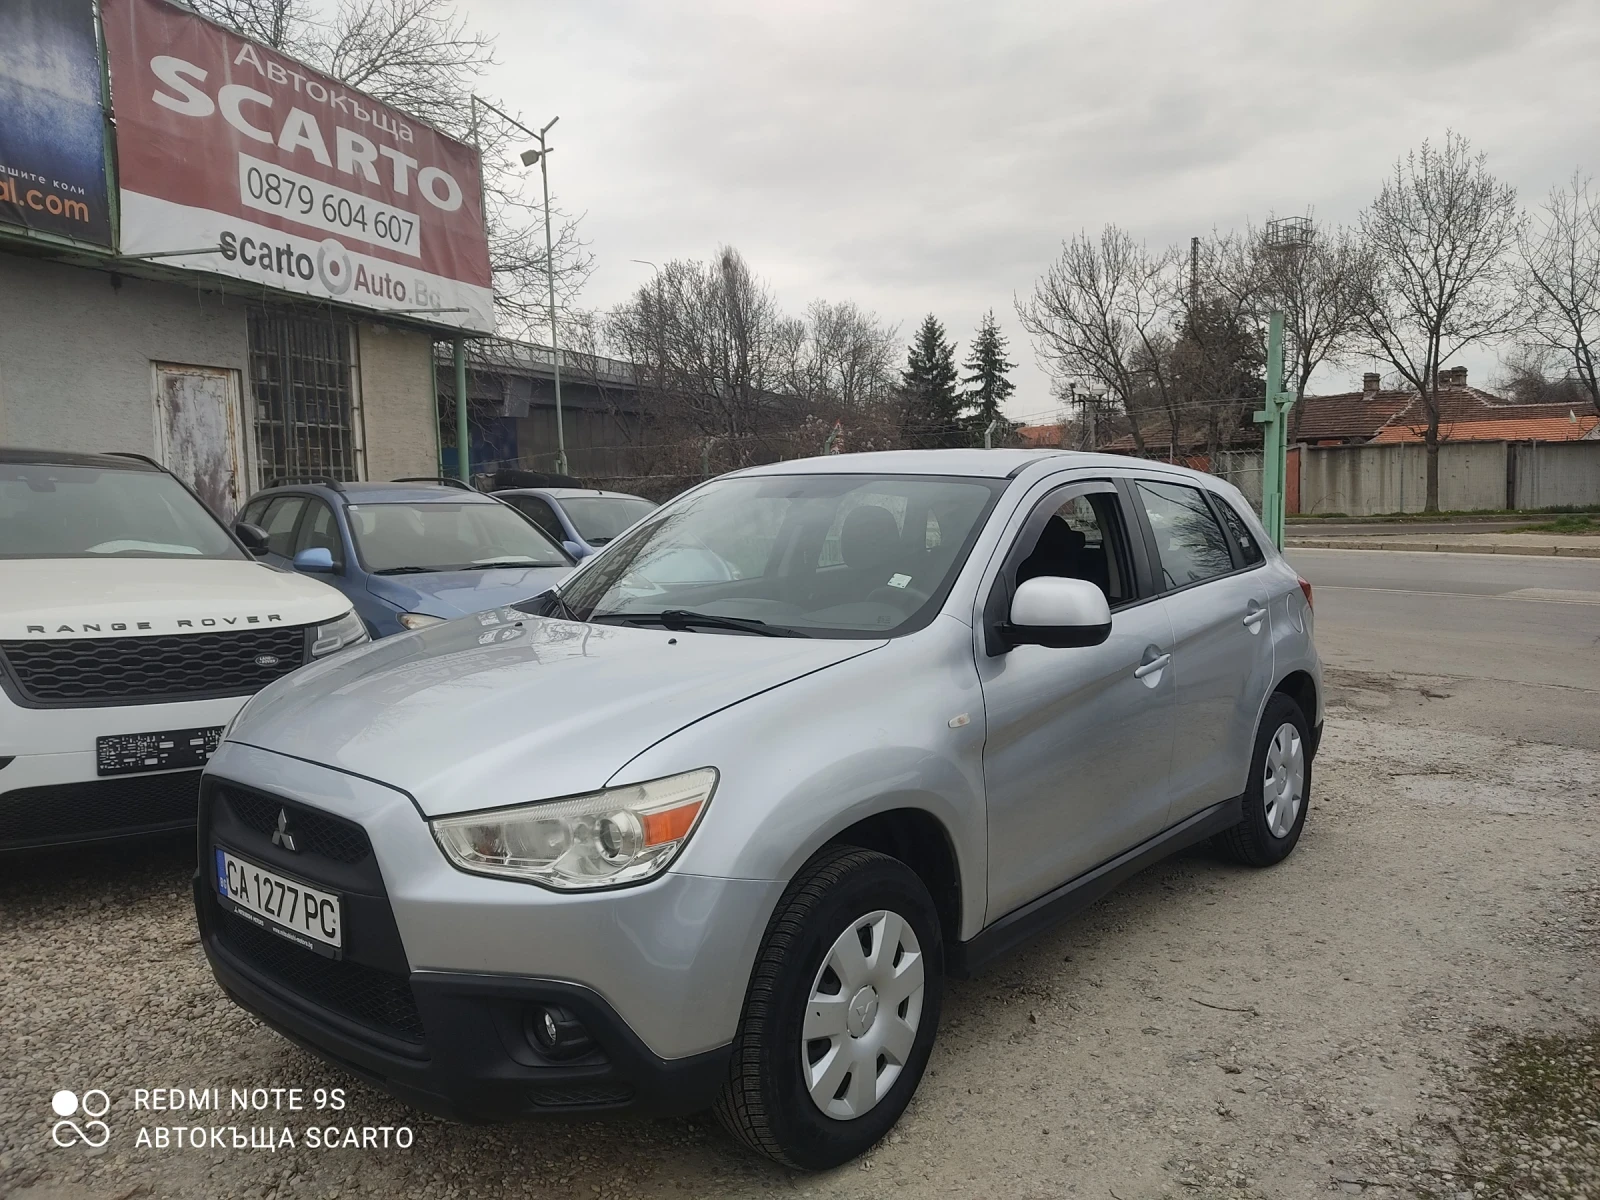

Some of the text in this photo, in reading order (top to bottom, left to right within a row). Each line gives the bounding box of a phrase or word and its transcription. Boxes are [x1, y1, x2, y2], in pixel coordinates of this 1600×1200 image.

[234, 43, 414, 144] Автокъща
[150, 55, 463, 212] SCARTO
[53, 179, 85, 196] коли
[247, 166, 414, 246] 0879 604 607
[219, 230, 315, 281] scarto
[27, 613, 282, 633] RANGE ROVER
